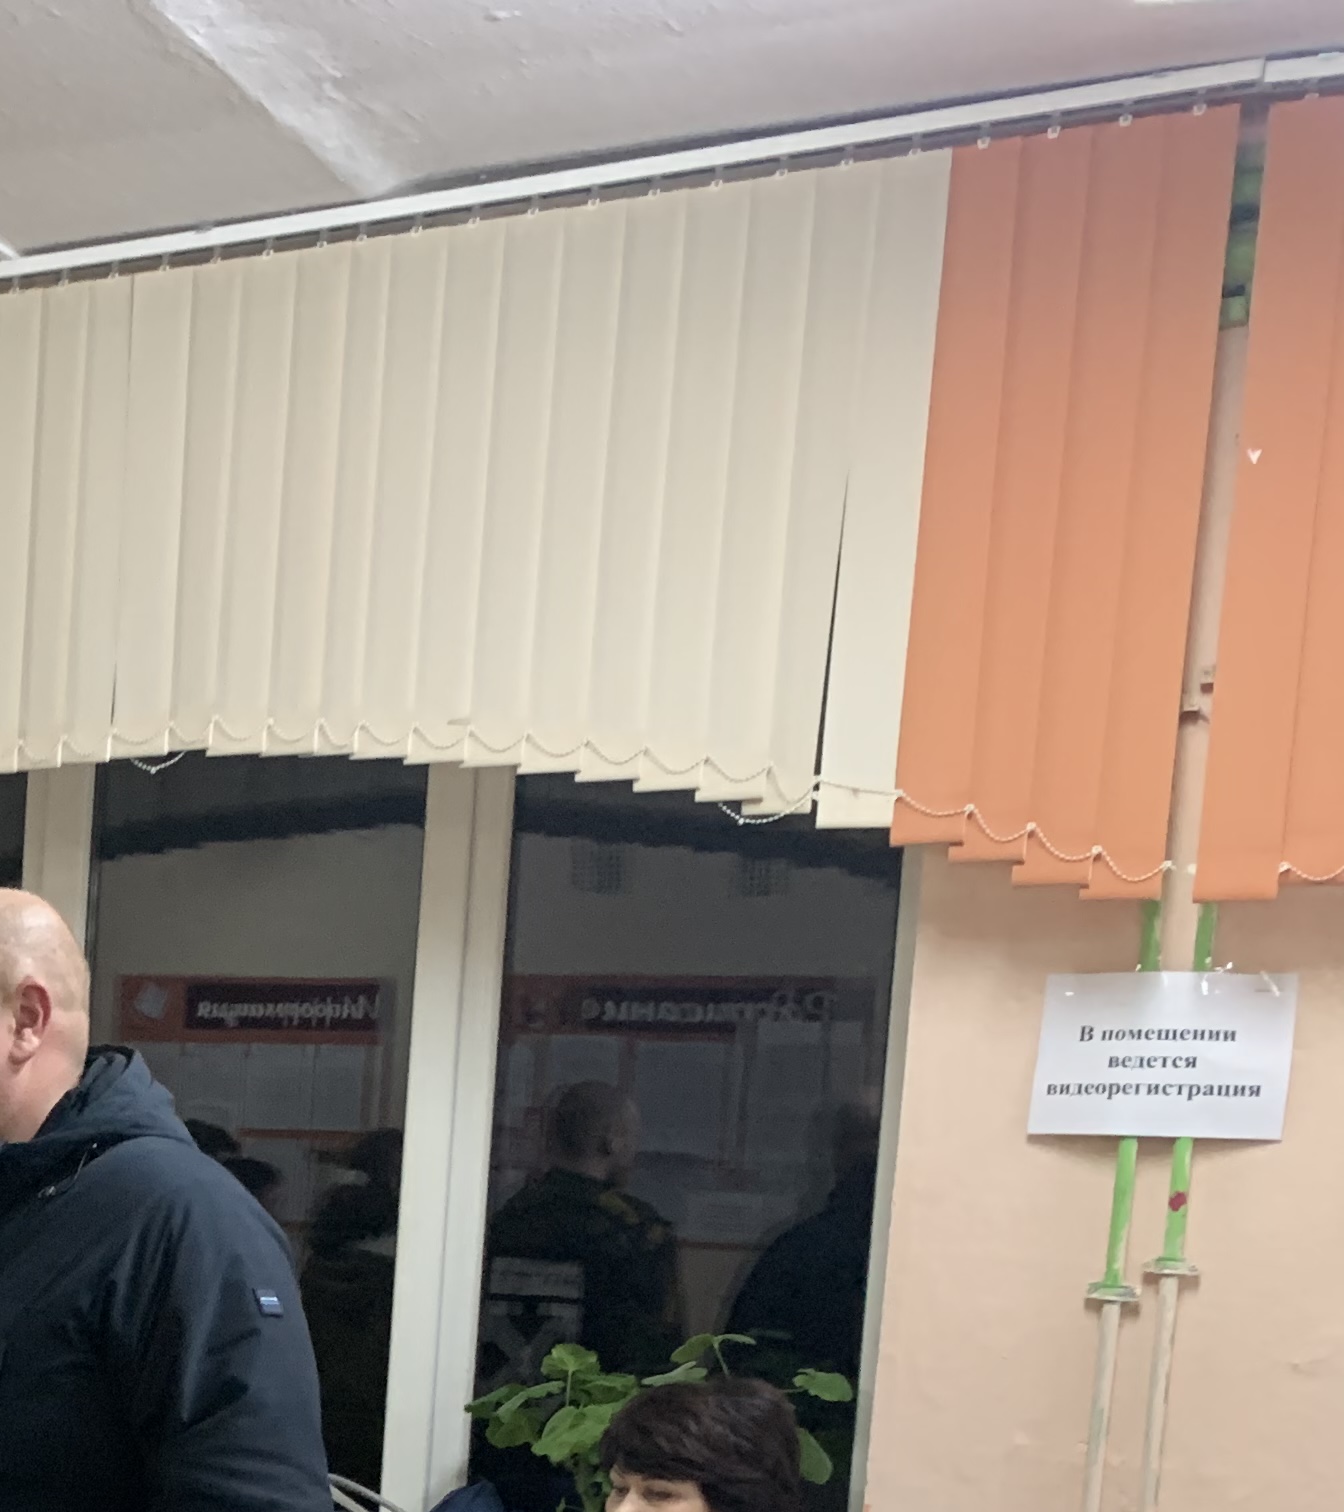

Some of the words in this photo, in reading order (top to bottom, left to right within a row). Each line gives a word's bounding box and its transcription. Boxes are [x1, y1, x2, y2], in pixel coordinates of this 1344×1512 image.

[1079, 1025, 1095, 1042] В
[1100, 1028, 1238, 1043] помещении
[1107, 1055, 1198, 1070] ведется
[1045, 1081, 1262, 1101] видеорегистрация
